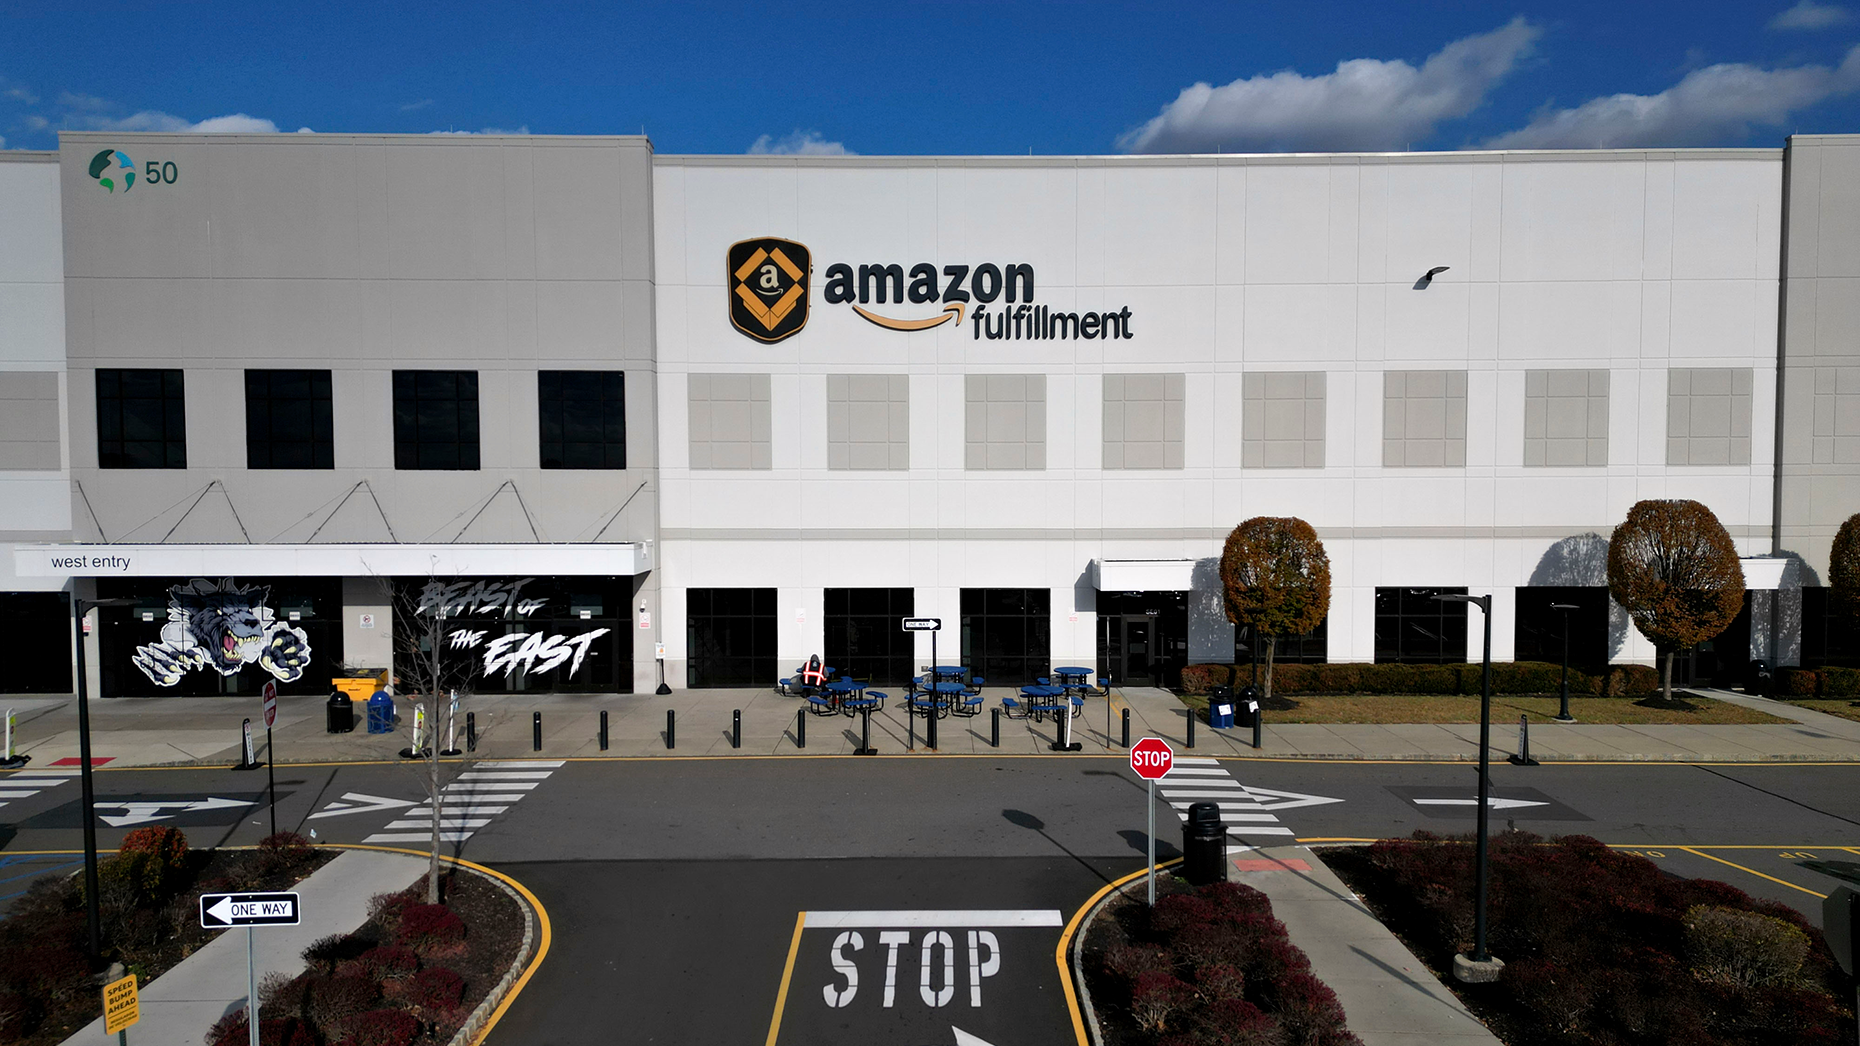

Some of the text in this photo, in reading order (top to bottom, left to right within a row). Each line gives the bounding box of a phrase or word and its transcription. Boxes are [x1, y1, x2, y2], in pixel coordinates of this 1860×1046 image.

[145, 161, 178, 184] 50
[760, 264, 779, 288] a
[823, 262, 1035, 304] amazon
[971, 304, 1134, 341] fulfillment
[51, 555, 131, 571] west entry
[413, 577, 550, 618] BEAST OF
[448, 629, 489, 651] THE
[482, 628, 611, 680] EAST
[1133, 750, 1171, 767] STOP
[231, 902, 288, 916] ONE WAY
[823, 930, 1000, 1008] STOP
[107, 980, 133, 997] SPEED
[108, 989, 133, 1005] BUMP
[107, 997, 136, 1015] AHEAD
